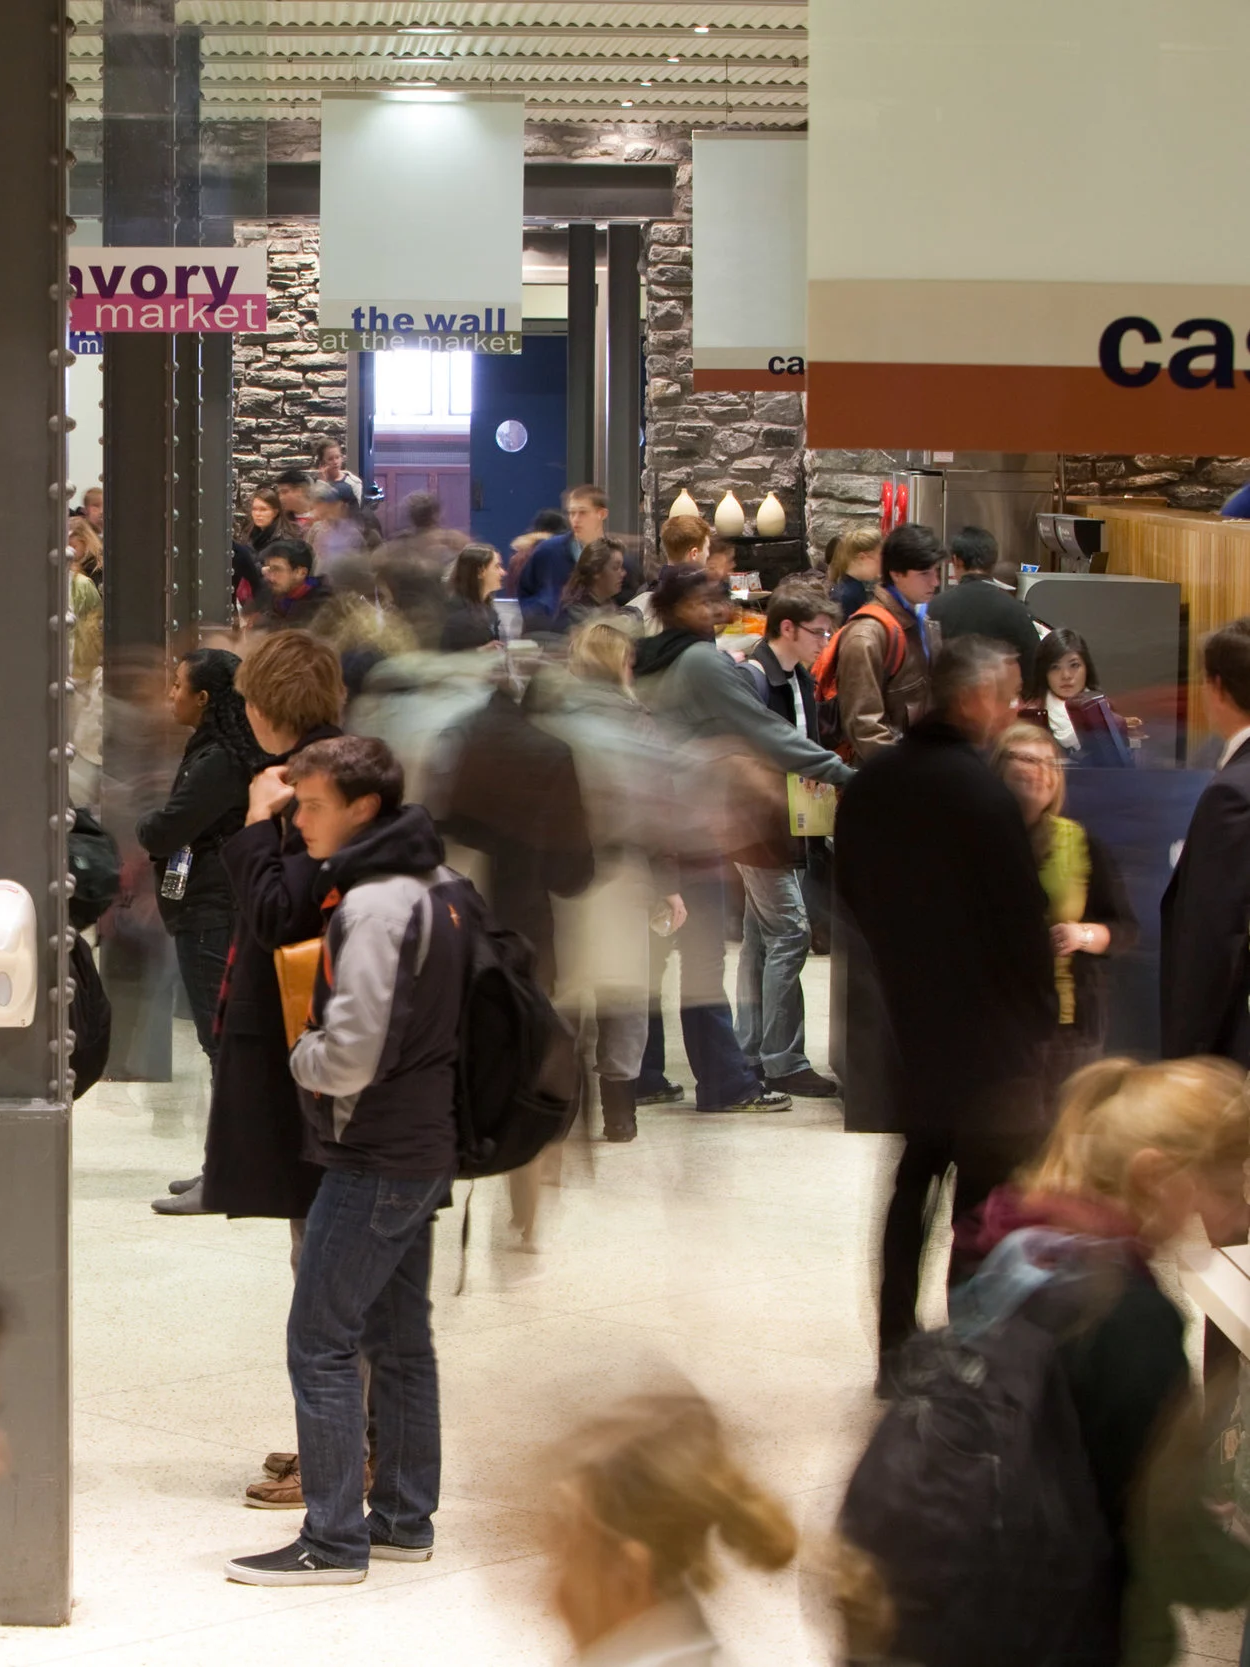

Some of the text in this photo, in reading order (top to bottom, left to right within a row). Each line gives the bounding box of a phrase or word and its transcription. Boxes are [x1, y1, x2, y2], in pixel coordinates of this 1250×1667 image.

[95, 297, 259, 329] market
[351, 306, 506, 334] the wall
[322, 331, 517, 352] at the market
[1099, 315, 1250, 390] ca
